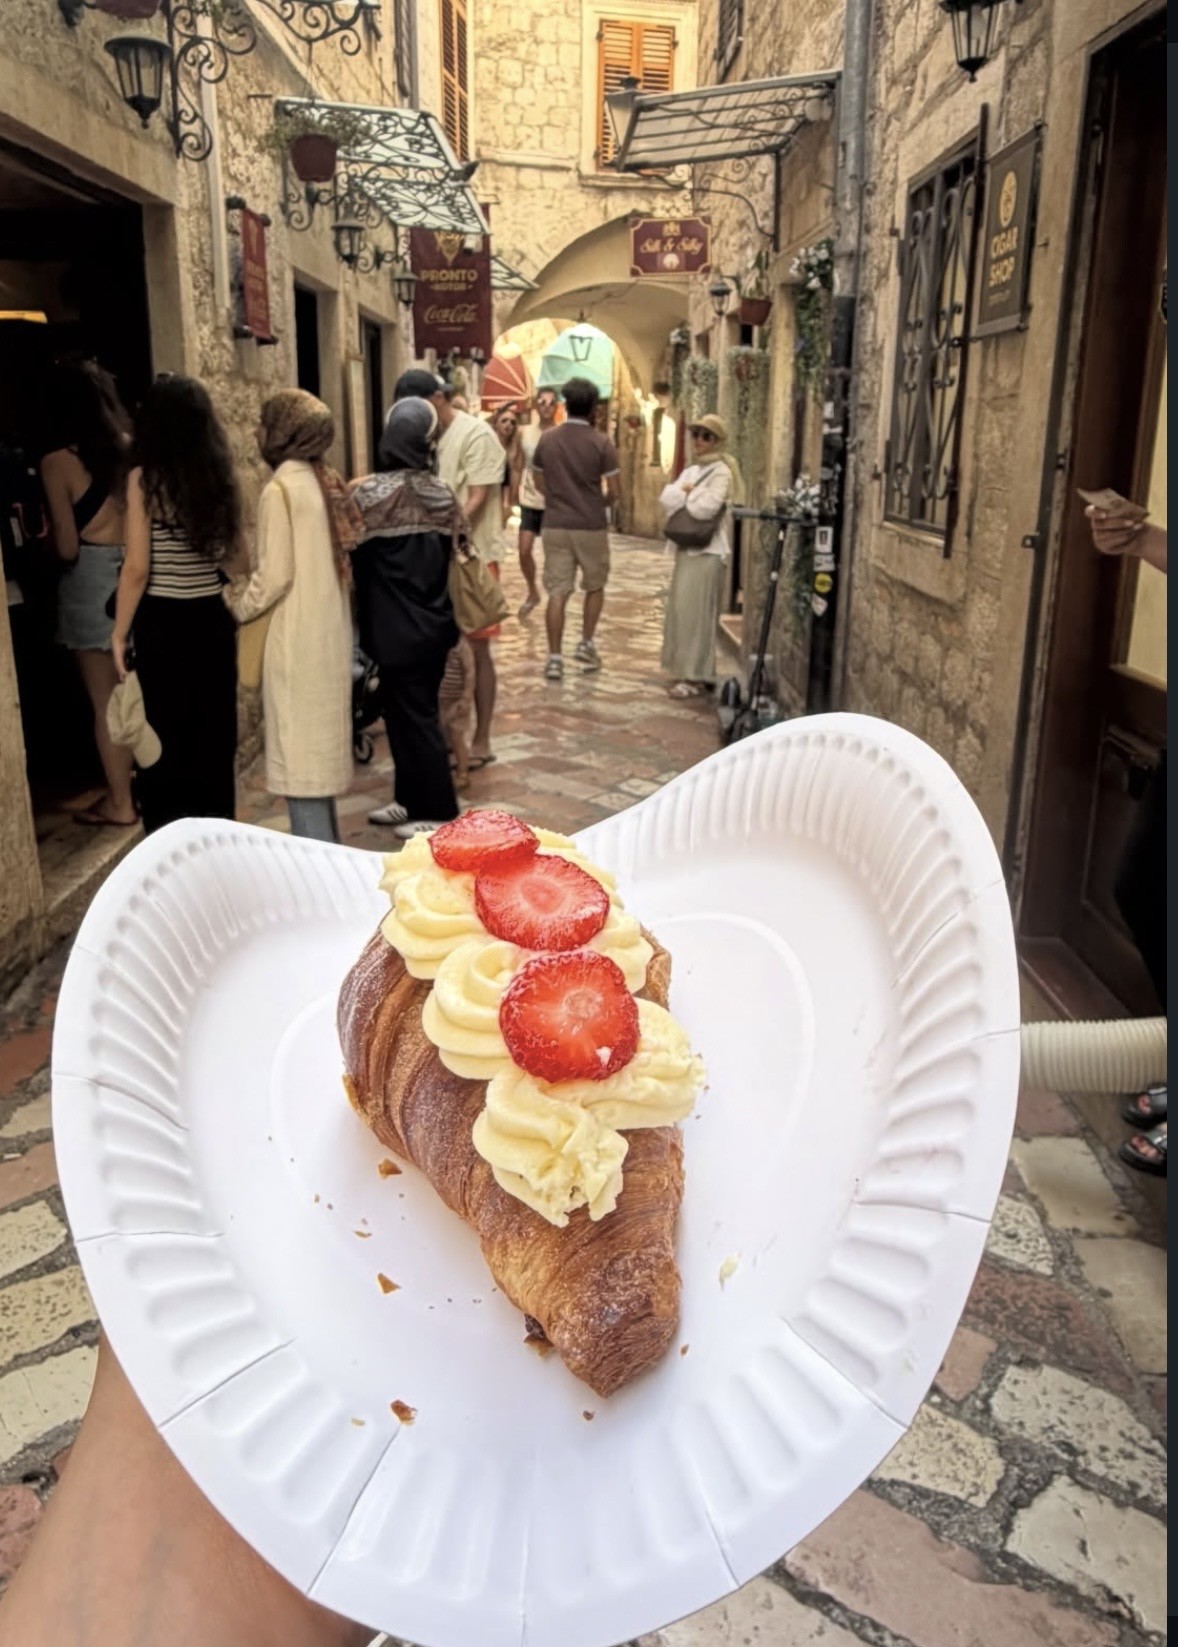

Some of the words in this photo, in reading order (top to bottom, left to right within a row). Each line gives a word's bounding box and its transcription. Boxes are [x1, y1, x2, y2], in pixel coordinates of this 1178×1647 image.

[991, 225, 1018, 258] CIGAR
[421, 268, 478, 283] PRONTO
[989, 256, 1016, 288] SHOP
